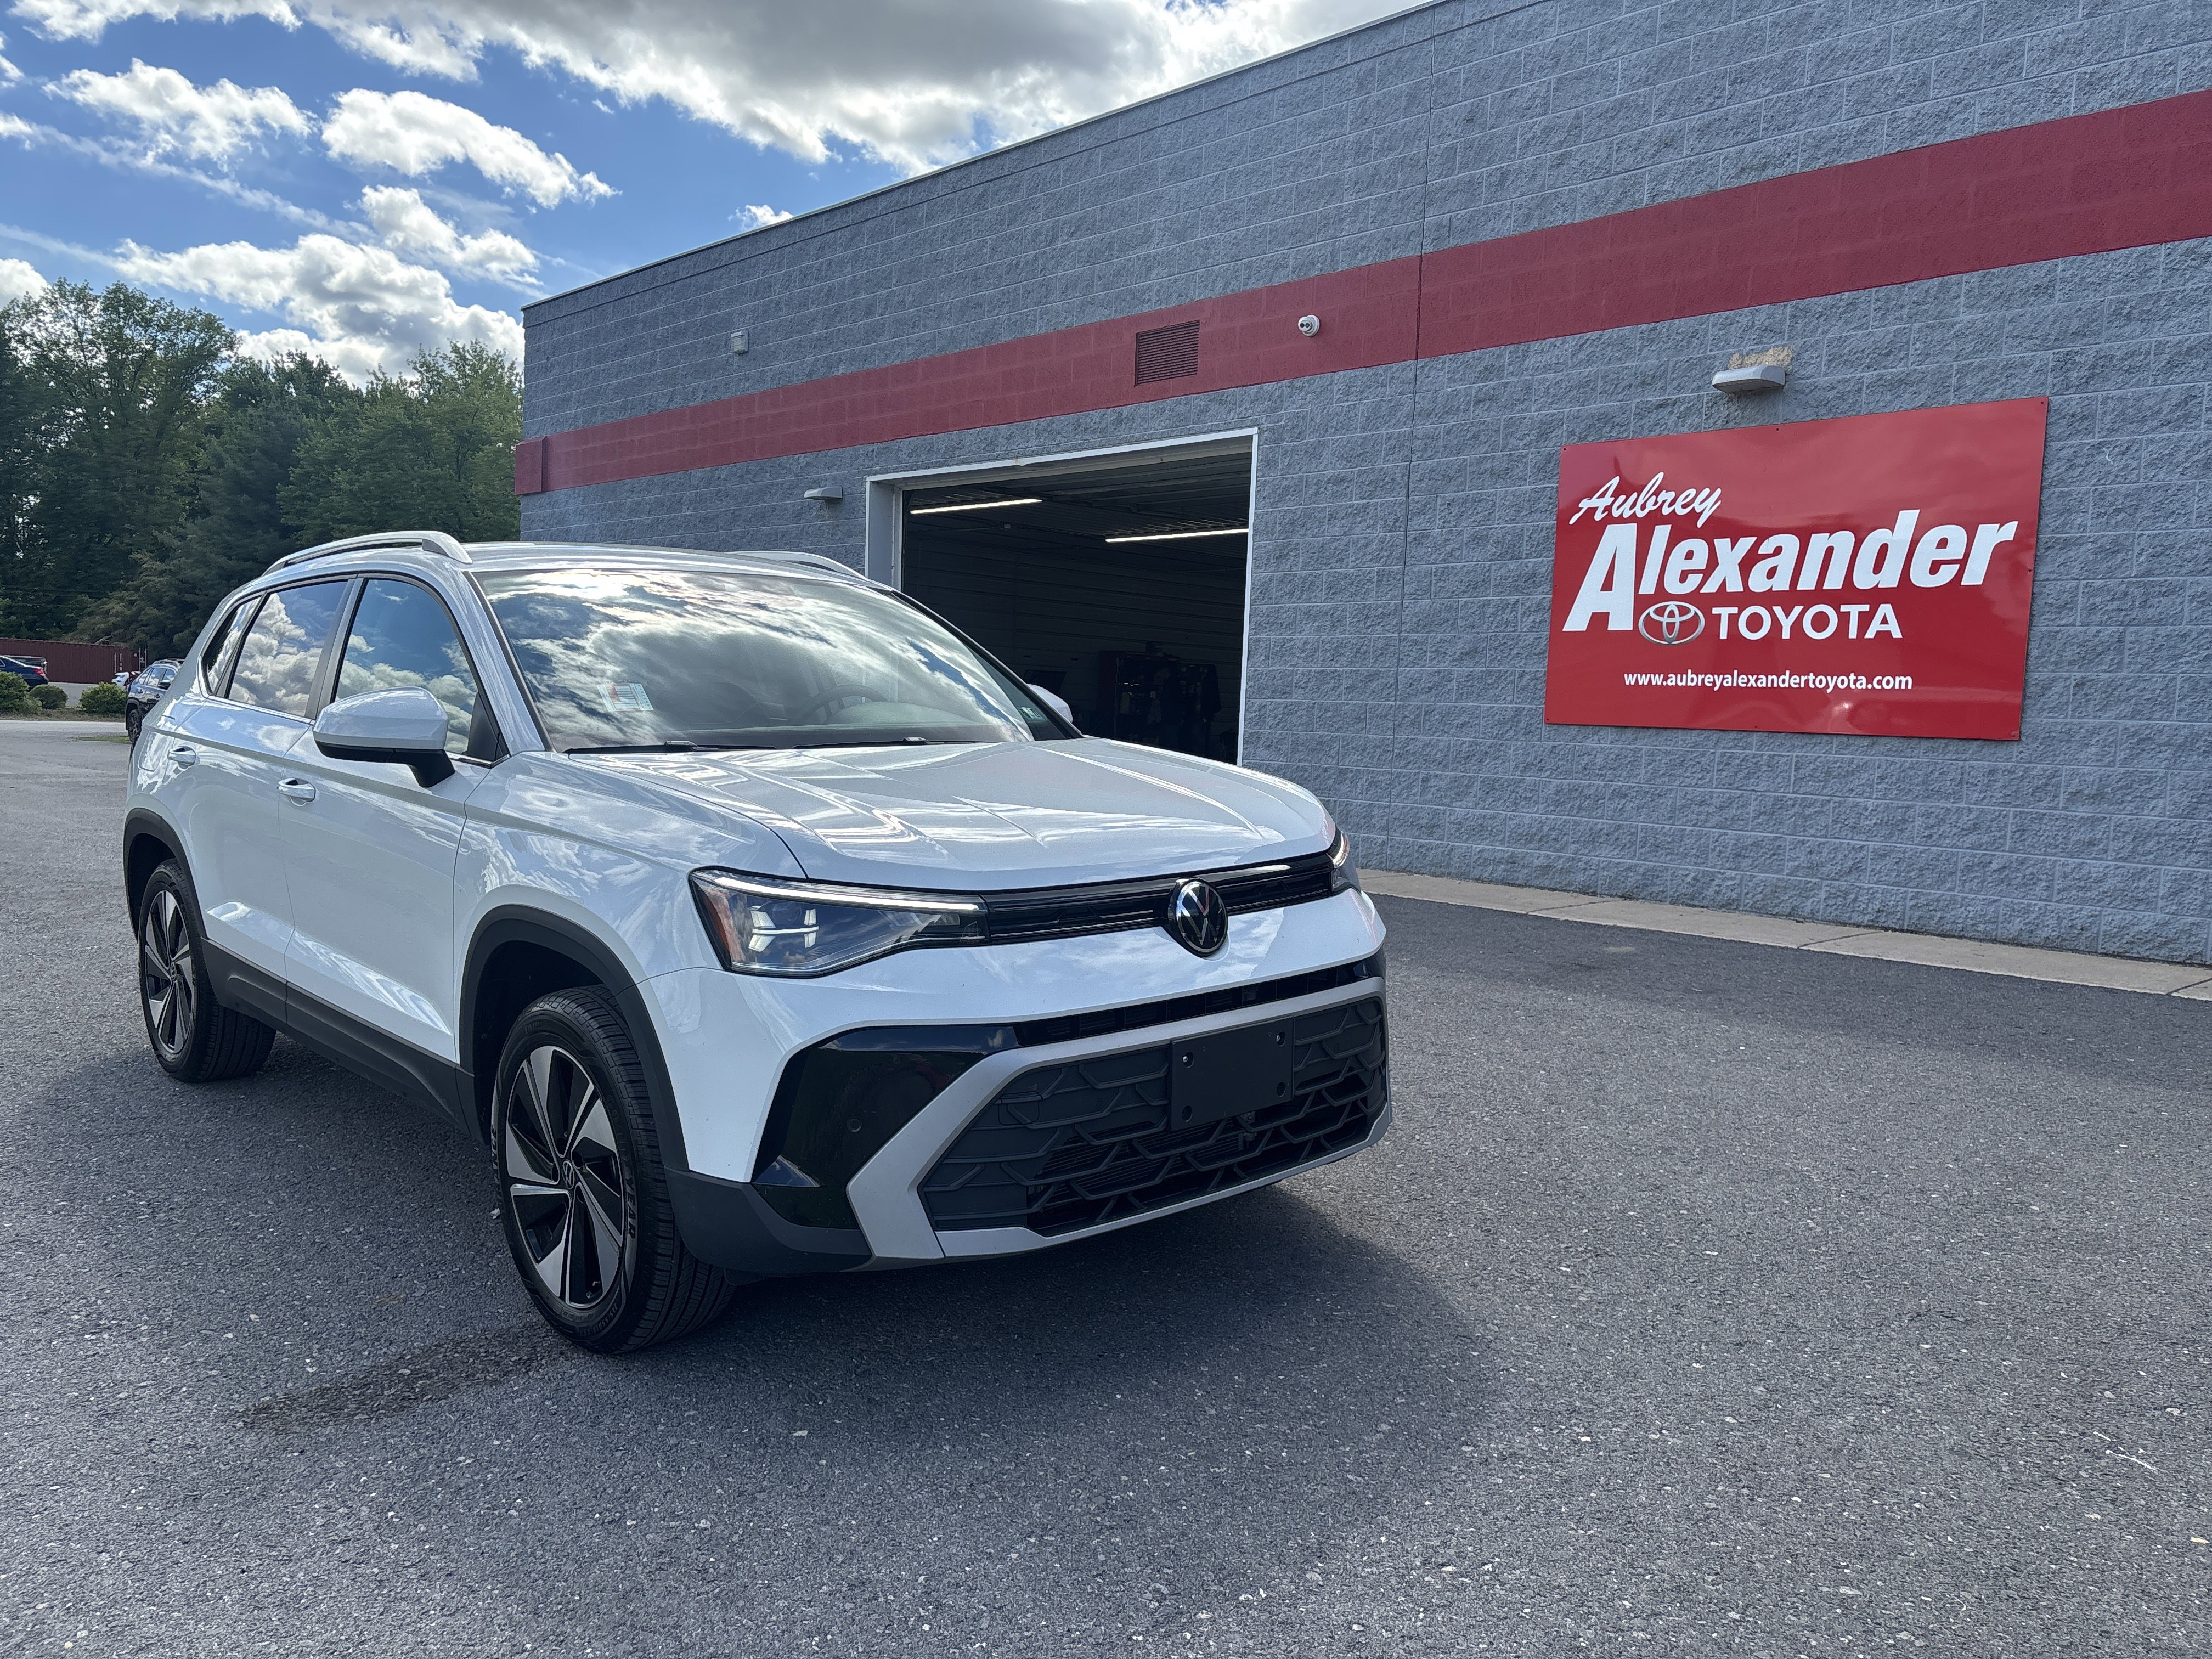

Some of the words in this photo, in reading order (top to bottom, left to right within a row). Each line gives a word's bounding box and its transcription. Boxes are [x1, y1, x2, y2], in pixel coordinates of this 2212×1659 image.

[1568, 471, 1722, 528] Aubrey
[1562, 509, 2019, 631] Alexander
[1711, 603, 1903, 640] TOYOTA
[1623, 668, 1913, 693] www.aubreyalexandertoyota.com
